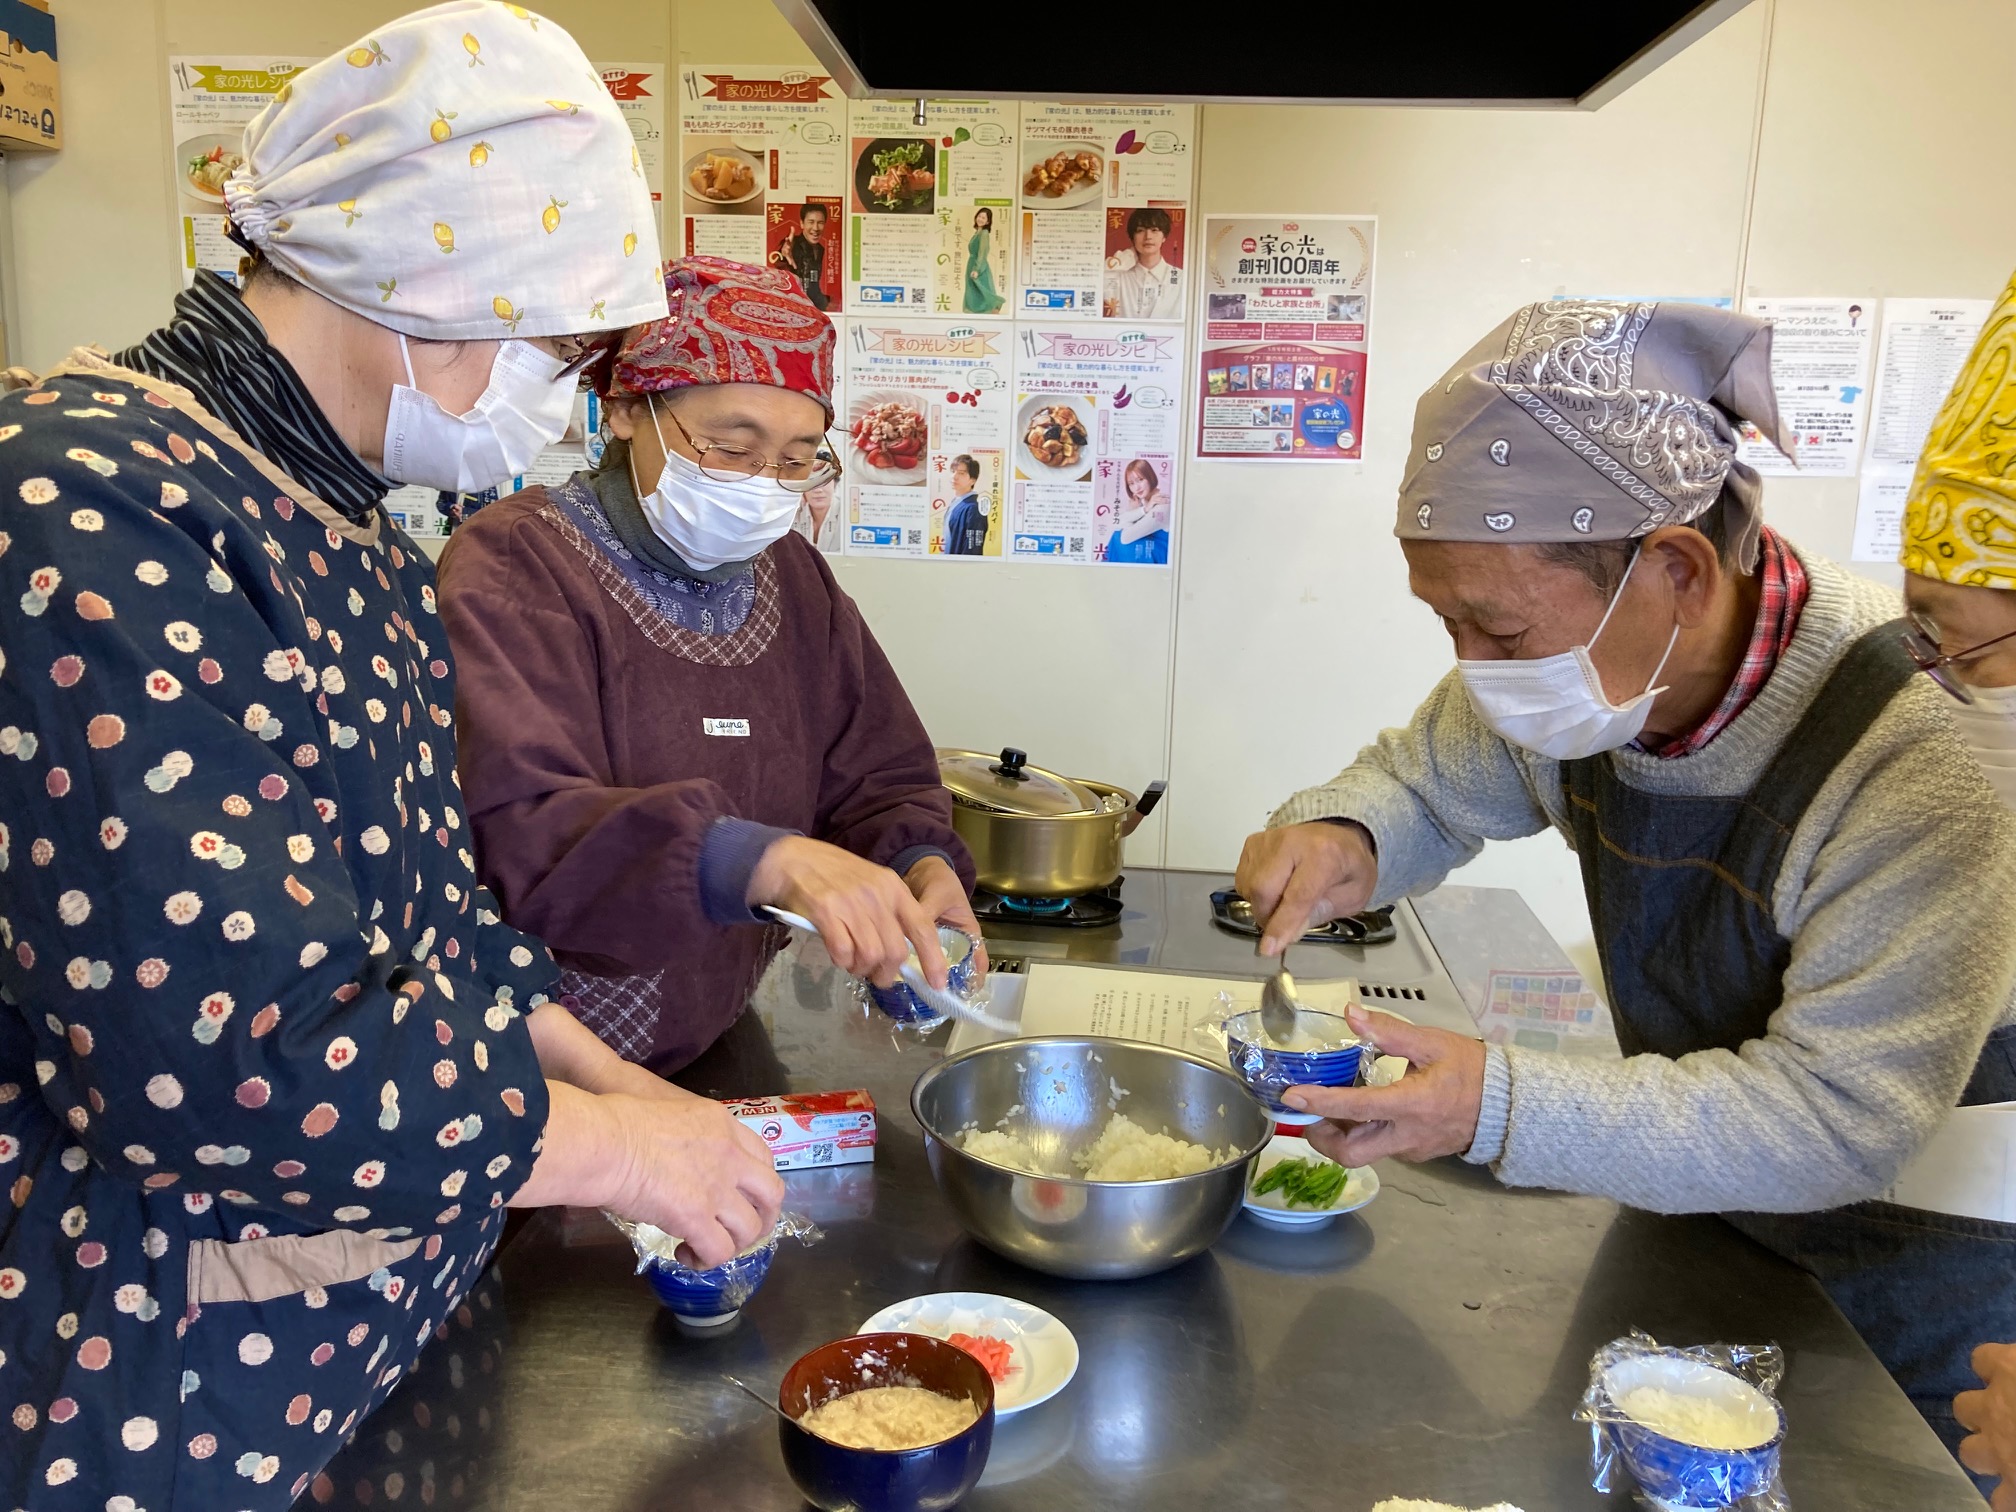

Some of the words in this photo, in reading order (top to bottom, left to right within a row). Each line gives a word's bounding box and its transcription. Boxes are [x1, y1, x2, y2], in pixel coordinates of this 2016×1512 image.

[725, 83, 811, 99] 家の光レシピ
[683, 120, 765, 130] 鶏もも肉とダイコンのうま煮
[1025, 126, 1094, 135] サツマイモの豚肉巻き
[828, 205, 841, 218] 12
[1260, 234, 1325, 256] 家の光は
[1238, 256, 1340, 276] 創刊100周年
[1231, 277, 1347, 285] さまざまな特別企画をお届けしていきます
[1247, 299, 1326, 309] 「わたしと家族と台所」
[950, 328, 974, 338] おすすめ
[1122, 334, 1146, 343] おすすめ
[892, 338, 976, 353] 家の光レシピ
[1062, 342, 1148, 358] 家の光レシピ
[853, 374, 937, 384] トマトのカリカリ豚肉がけ
[1019, 380, 1099, 389] ナスと鶏肉のしぎ焼き風
[1312, 407, 1341, 420] 家の光
[992, 456, 1000, 468] 8
[1160, 461, 1169, 473] 9
[876, 528, 899, 536] Twitter
[743, 1106, 776, 1115] NEW
